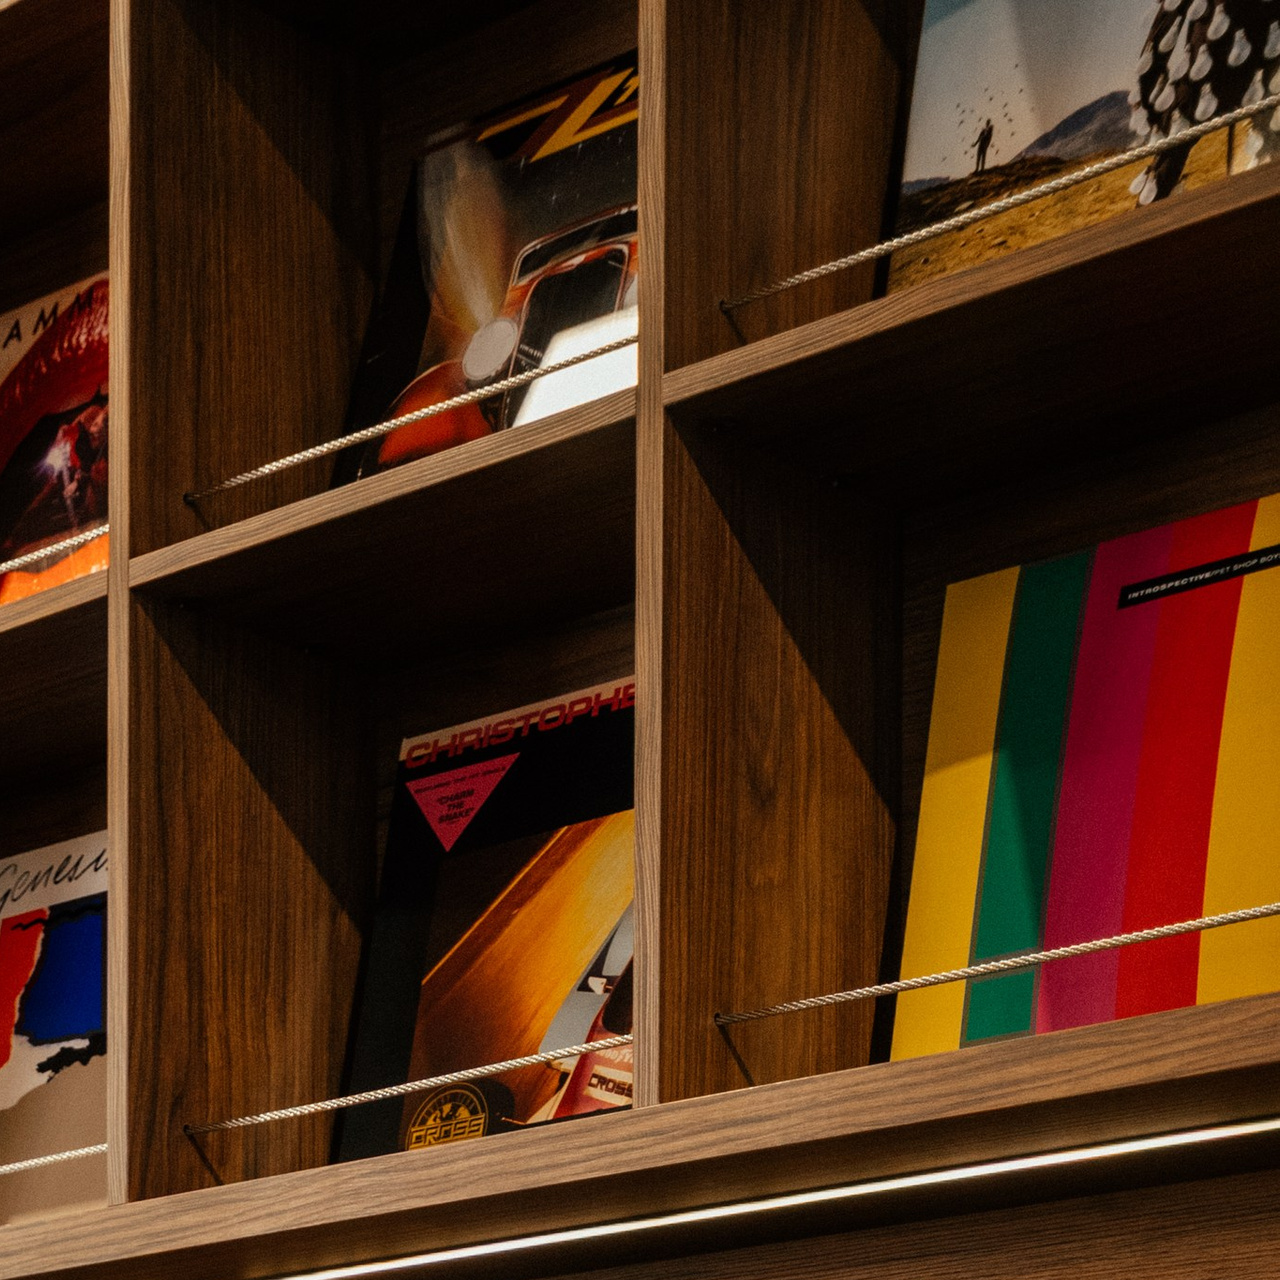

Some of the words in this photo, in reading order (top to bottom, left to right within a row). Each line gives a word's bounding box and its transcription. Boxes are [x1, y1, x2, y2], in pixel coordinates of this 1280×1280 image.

[1232, 558, 1258, 572] SHOP
[405, 682, 635, 770] CHRISTOPHE
[447, 801, 465, 812] THE
[410, 1115, 484, 1147] CROSS
